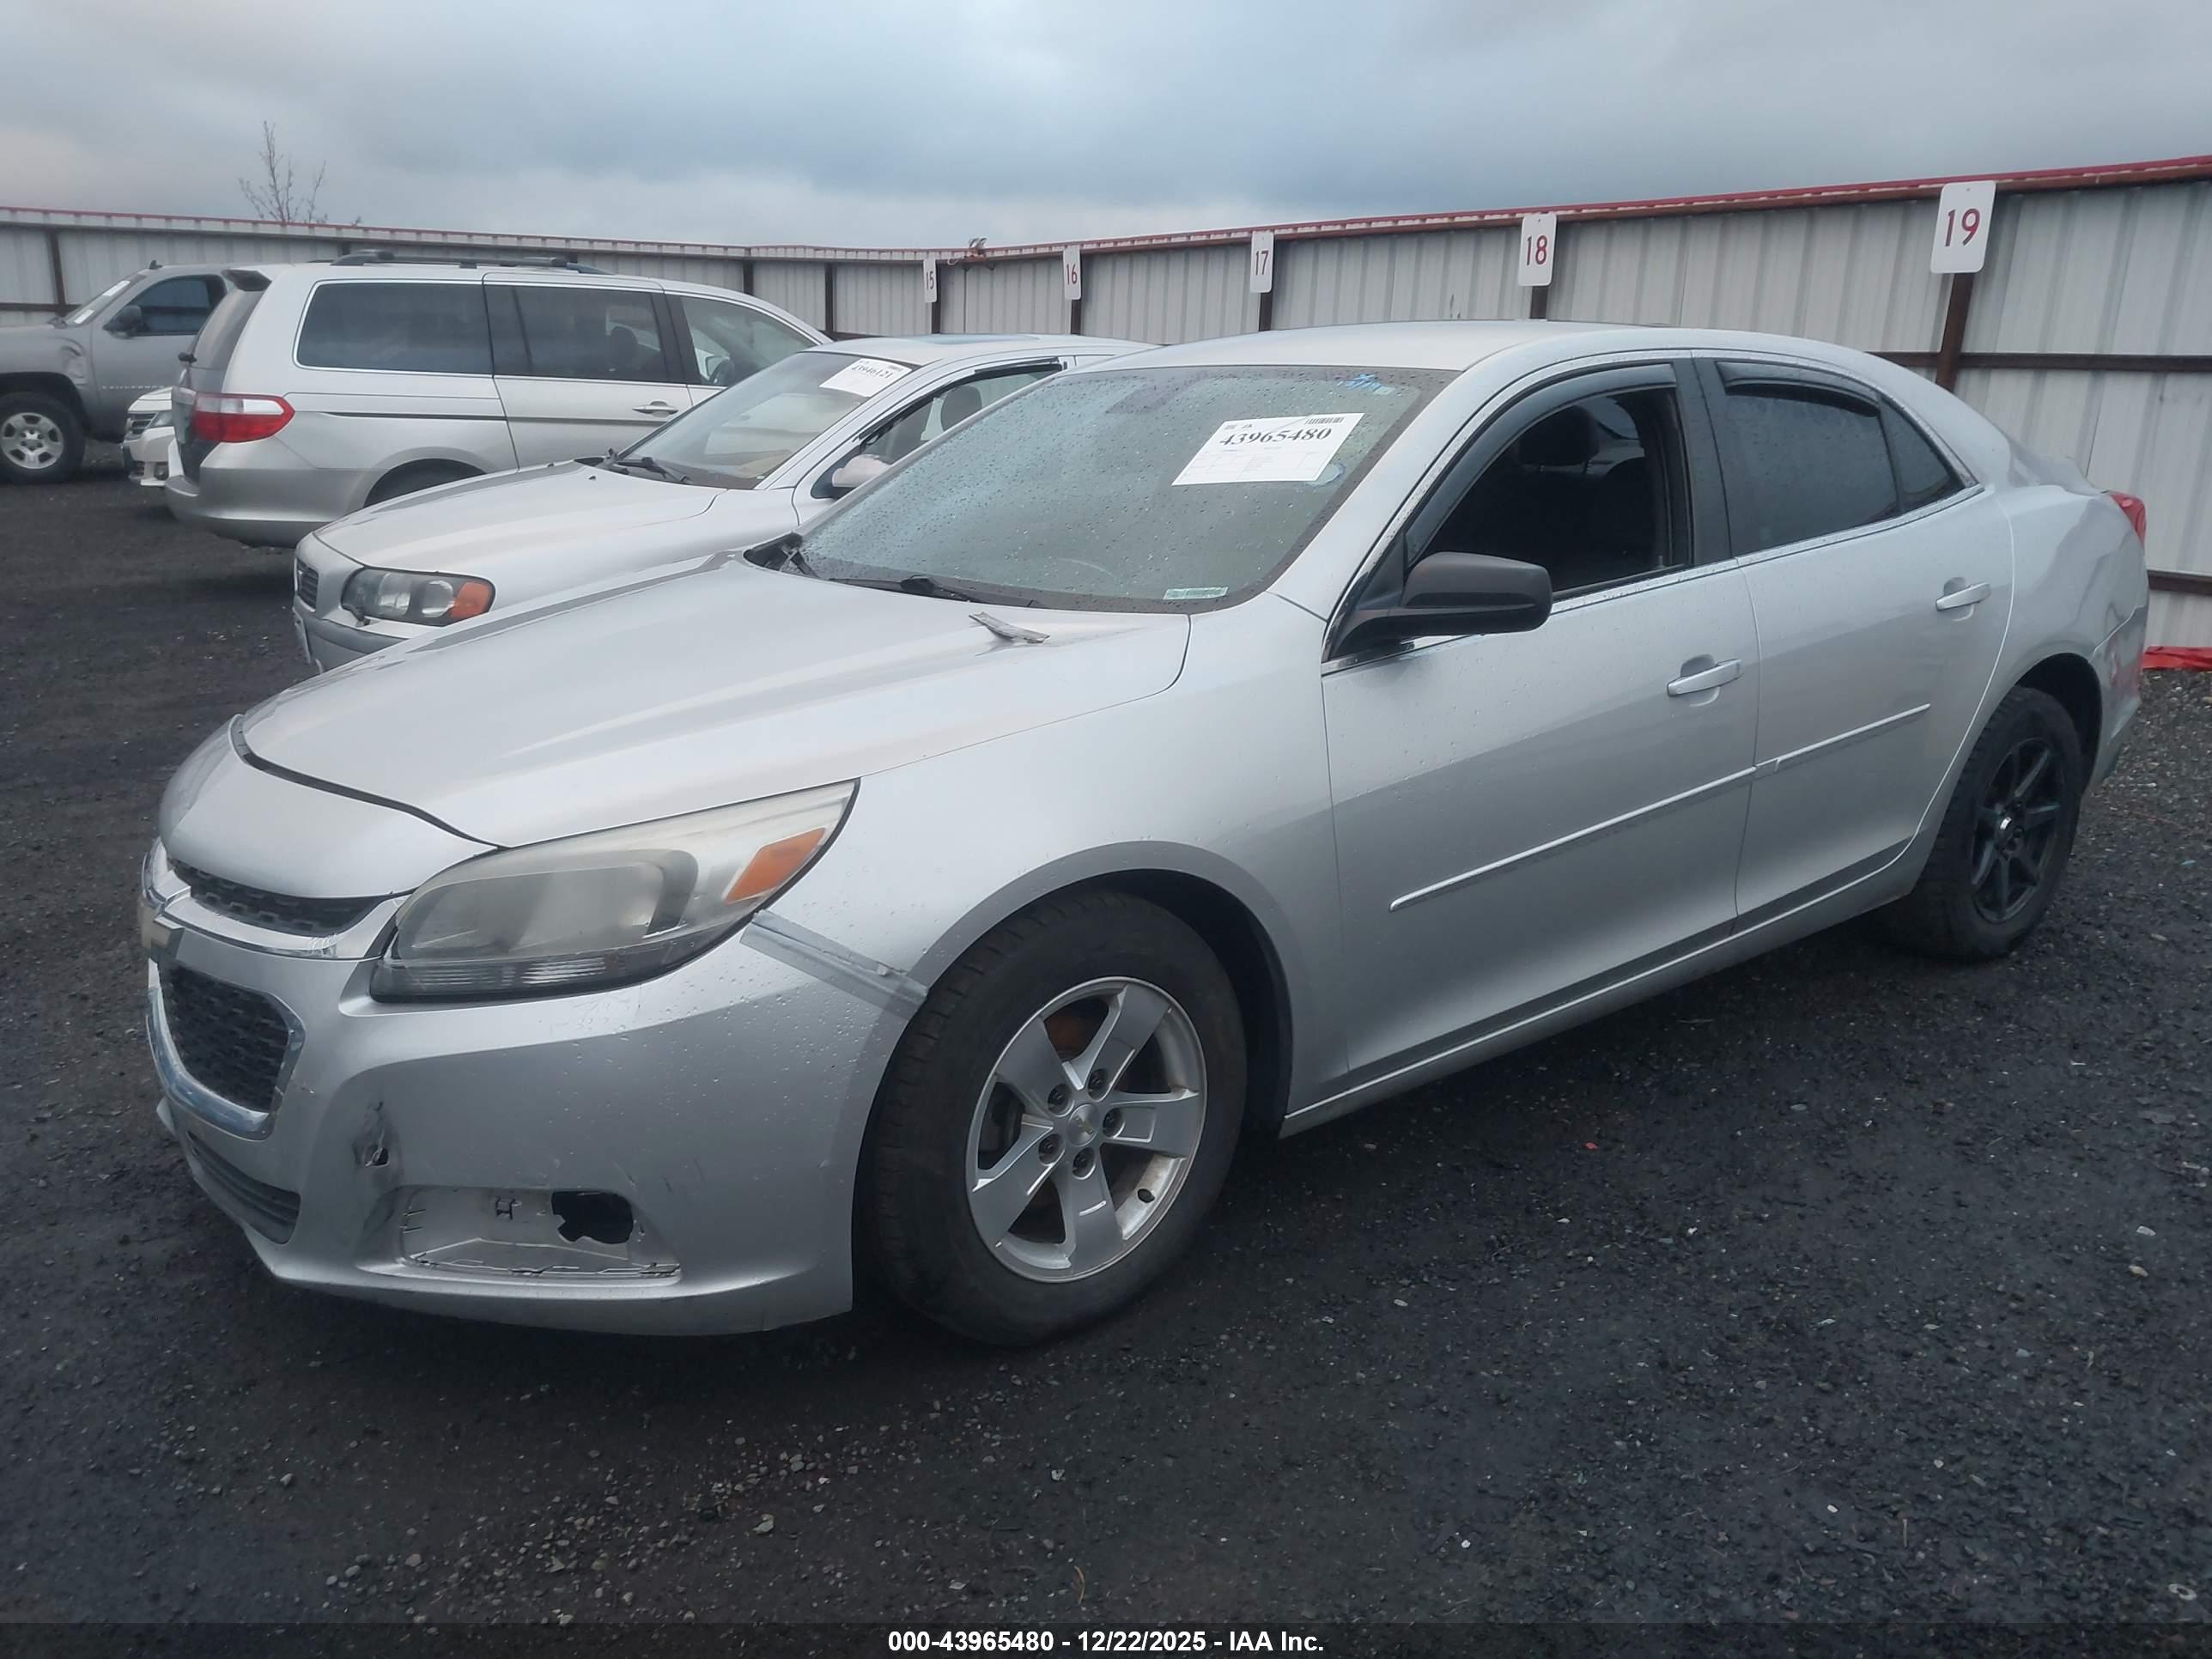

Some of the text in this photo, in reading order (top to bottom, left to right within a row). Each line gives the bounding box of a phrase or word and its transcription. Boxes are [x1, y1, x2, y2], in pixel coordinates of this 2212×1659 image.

[1944, 208, 1980, 247] 19
[1525, 234, 1548, 266] 18
[1066, 263, 1078, 285] 16
[1254, 249, 1269, 276] 17
[926, 270, 934, 289] 15
[1219, 428, 1333, 446] 43965480
